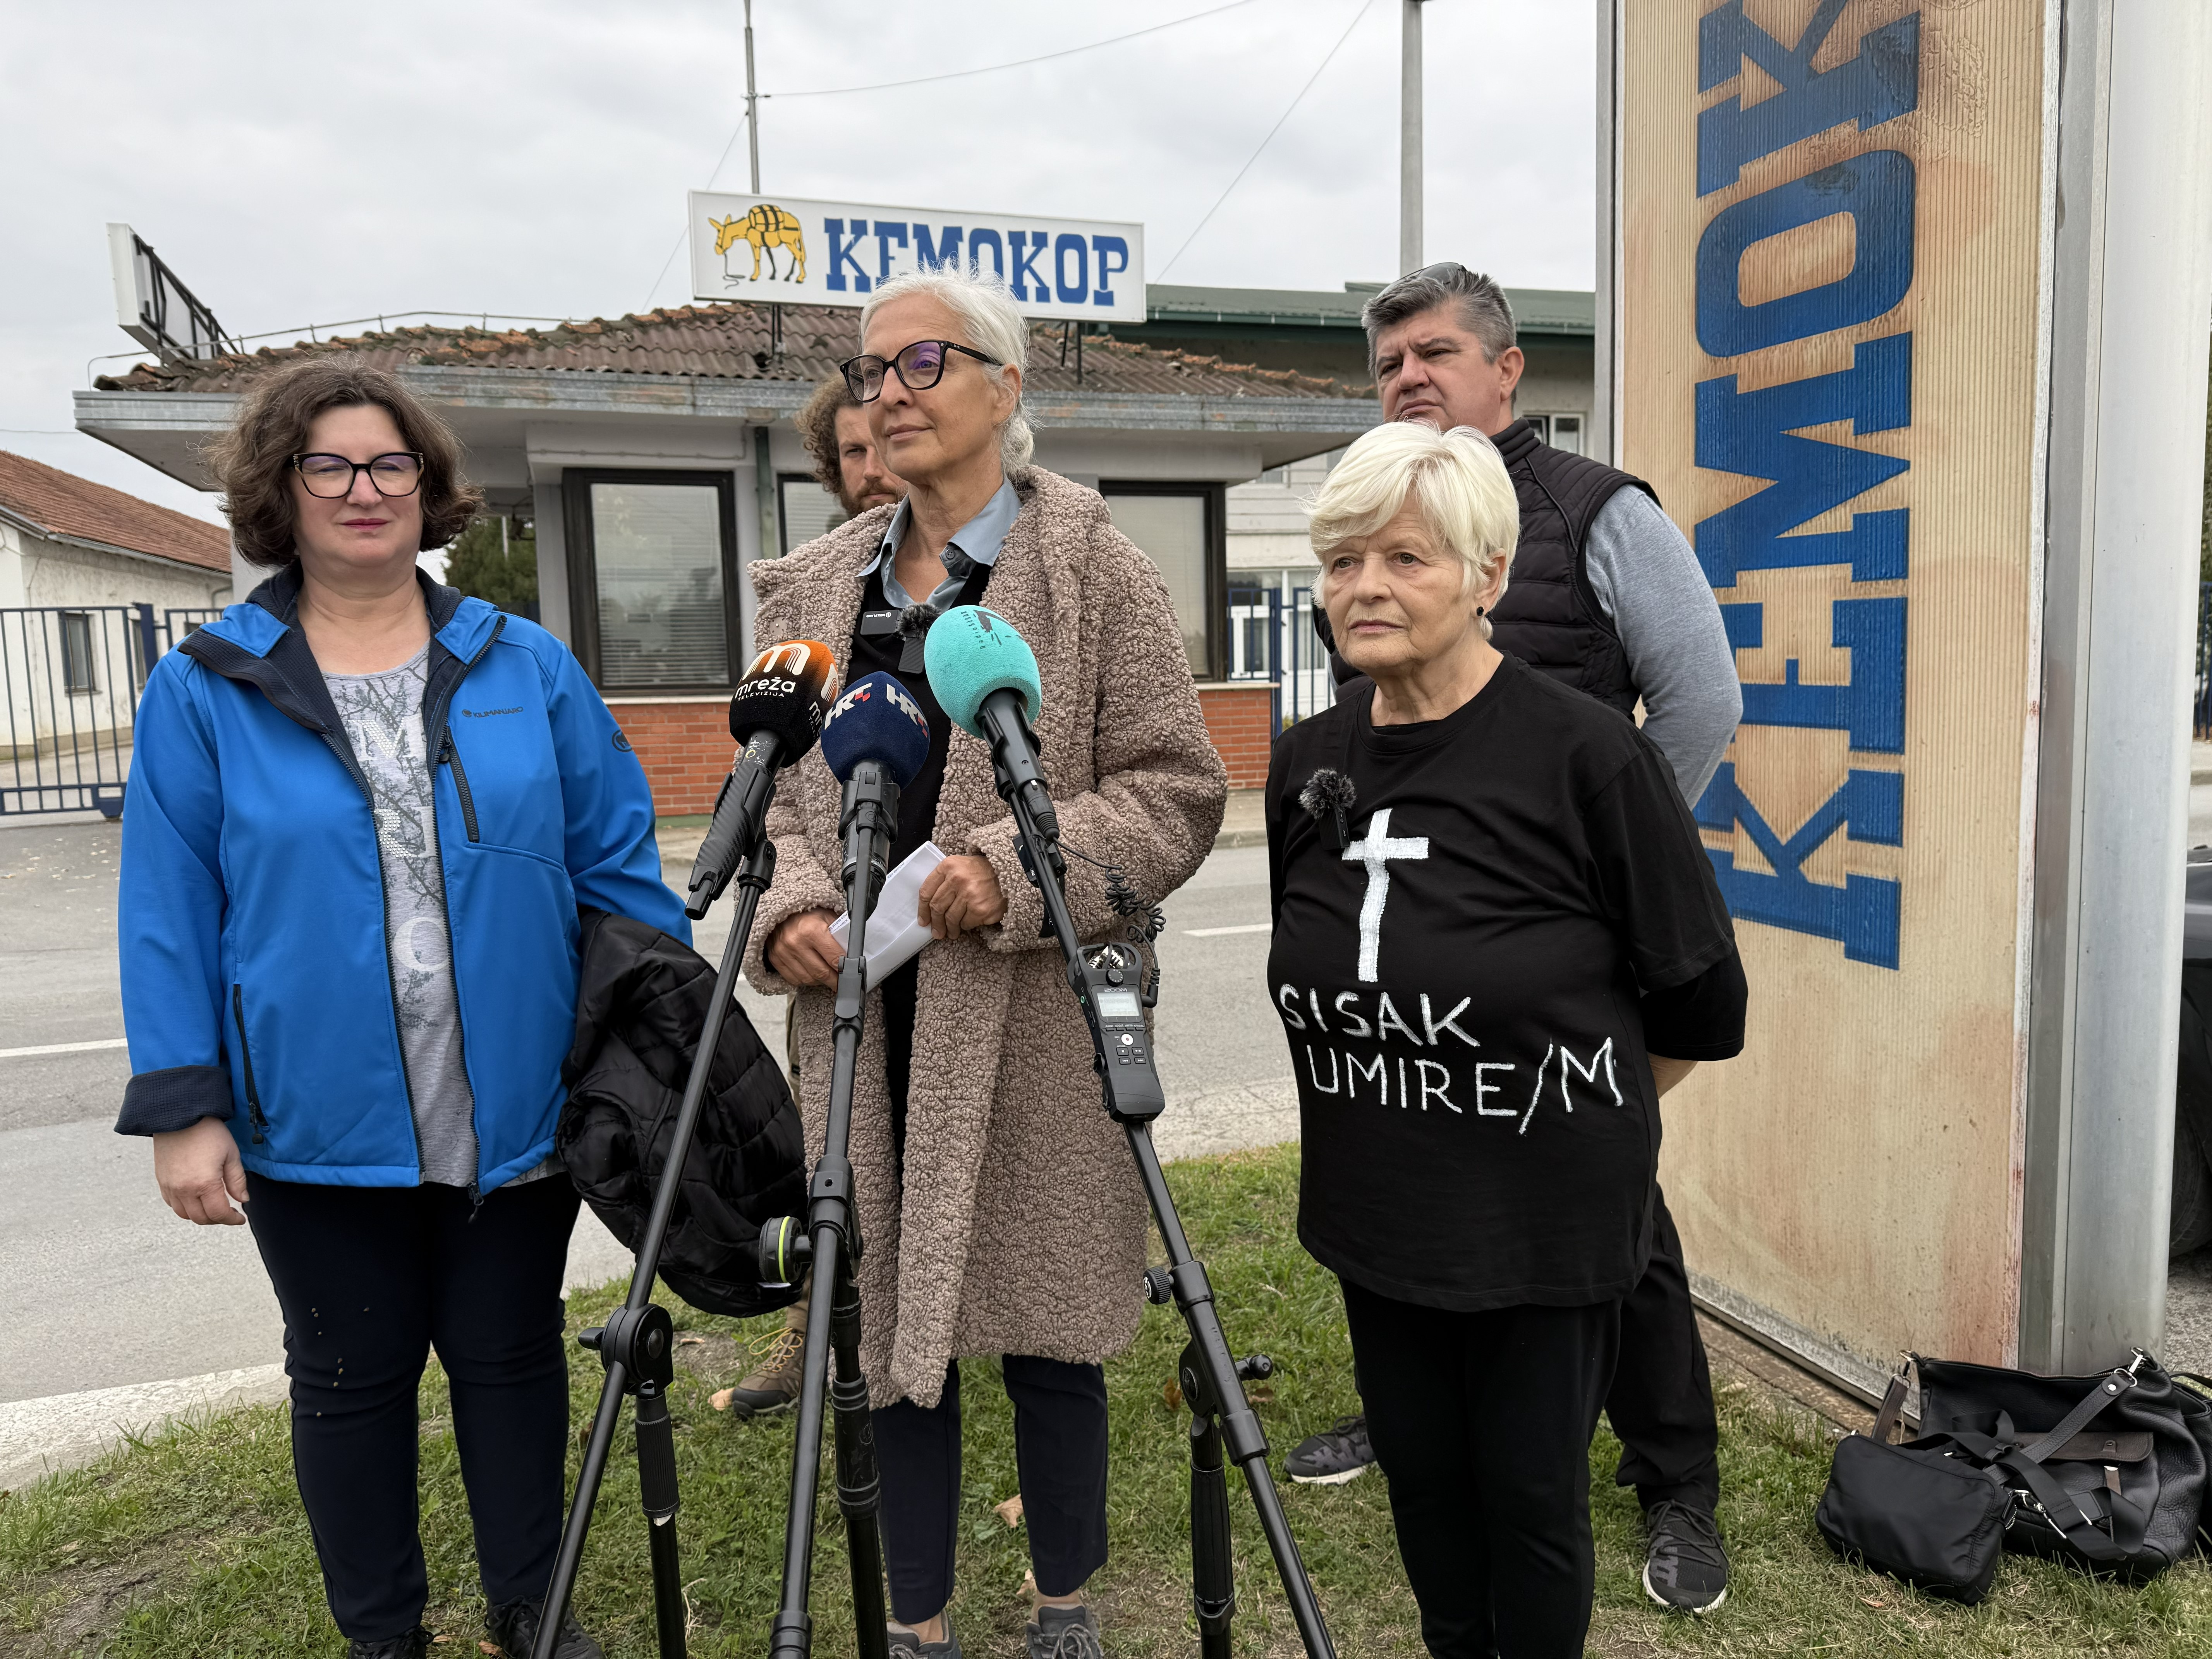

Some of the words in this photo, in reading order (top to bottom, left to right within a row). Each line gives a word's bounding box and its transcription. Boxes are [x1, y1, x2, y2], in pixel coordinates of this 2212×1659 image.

[473, 706, 523, 718] KILIMANJARO
[735, 677, 796, 699] mreža
[738, 691, 784, 701] TELEVIZIJA
[824, 682, 872, 730] HRT
[886, 683, 928, 738] HRT
[1279, 983, 1480, 1047] SISAK
[1307, 1037, 1623, 1135] UMIRE/M
